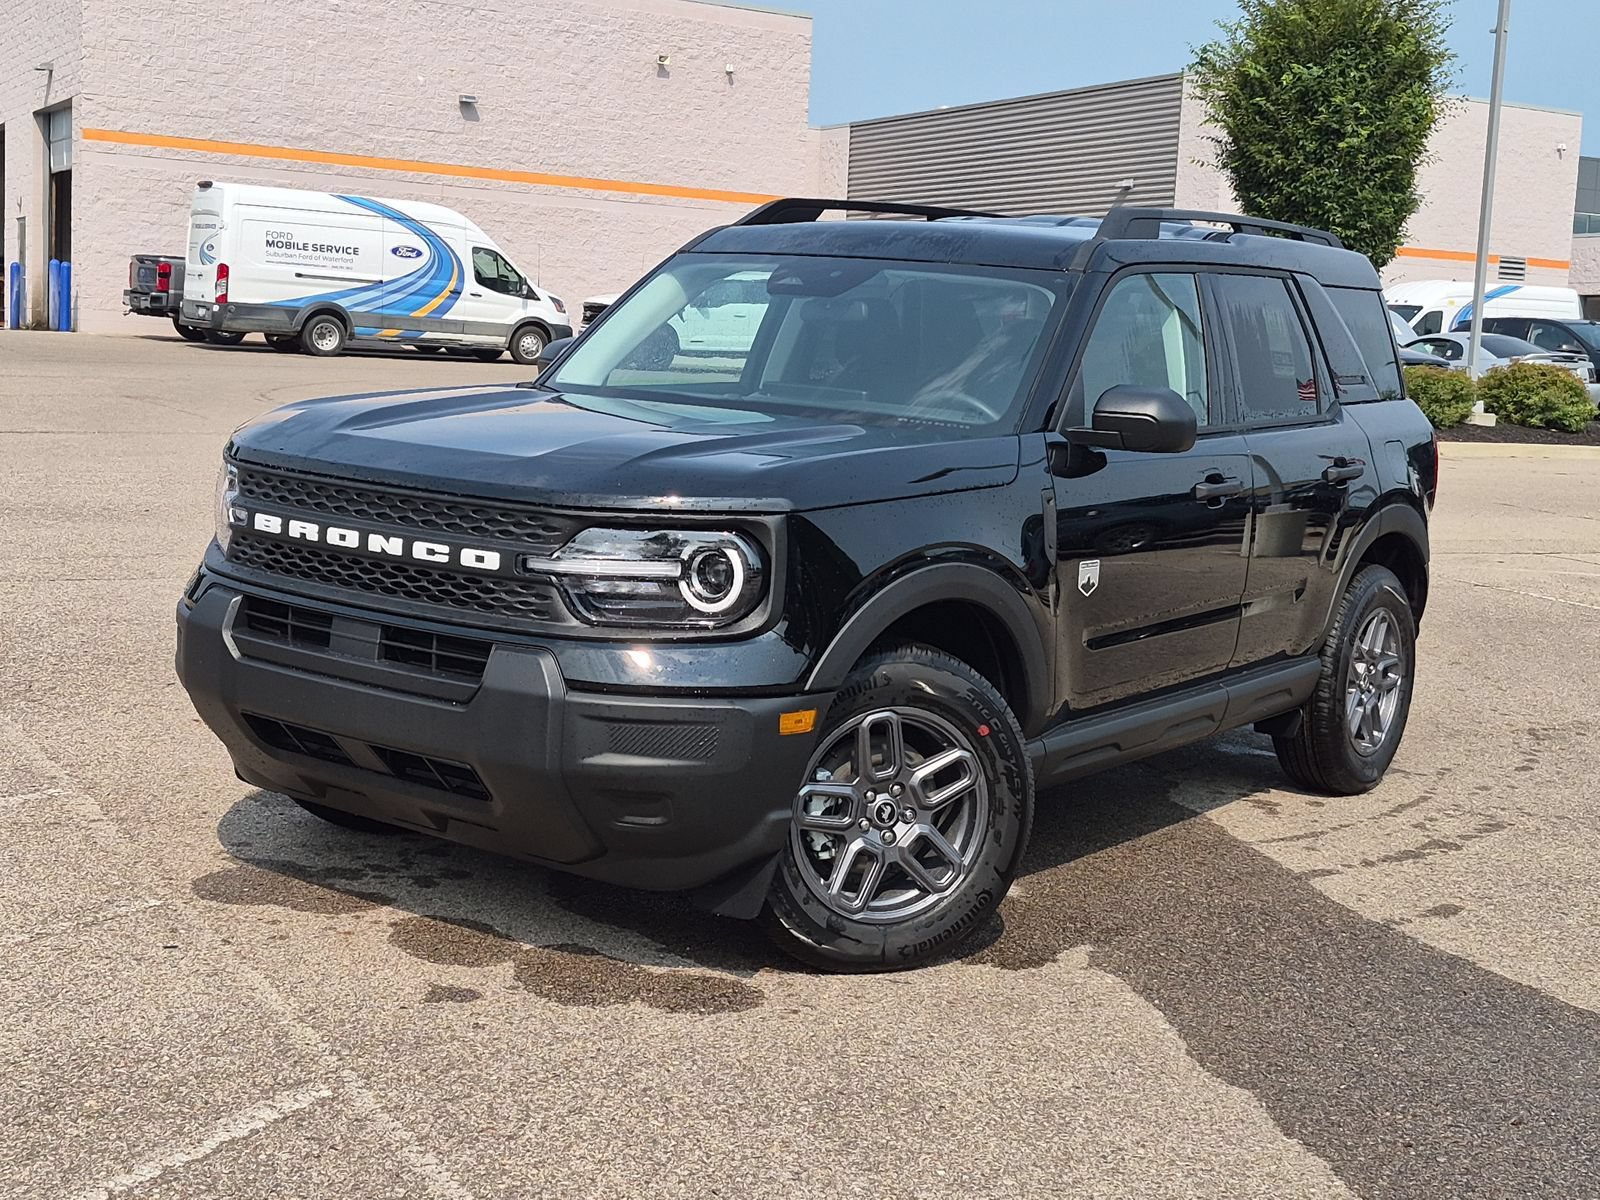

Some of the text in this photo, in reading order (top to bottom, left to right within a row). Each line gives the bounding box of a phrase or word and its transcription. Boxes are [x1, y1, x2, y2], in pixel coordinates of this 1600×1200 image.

[265, 230, 294, 241] FORD
[265, 239, 360, 256] MOBILE SERVICE
[395, 246, 419, 258] Ford
[265, 250, 297, 260] Suburban
[298, 253, 313, 261] Ford
[322, 255, 354, 264] Waterford
[253, 512, 501, 571] BRONCO
[912, 889, 993, 954] Continental
